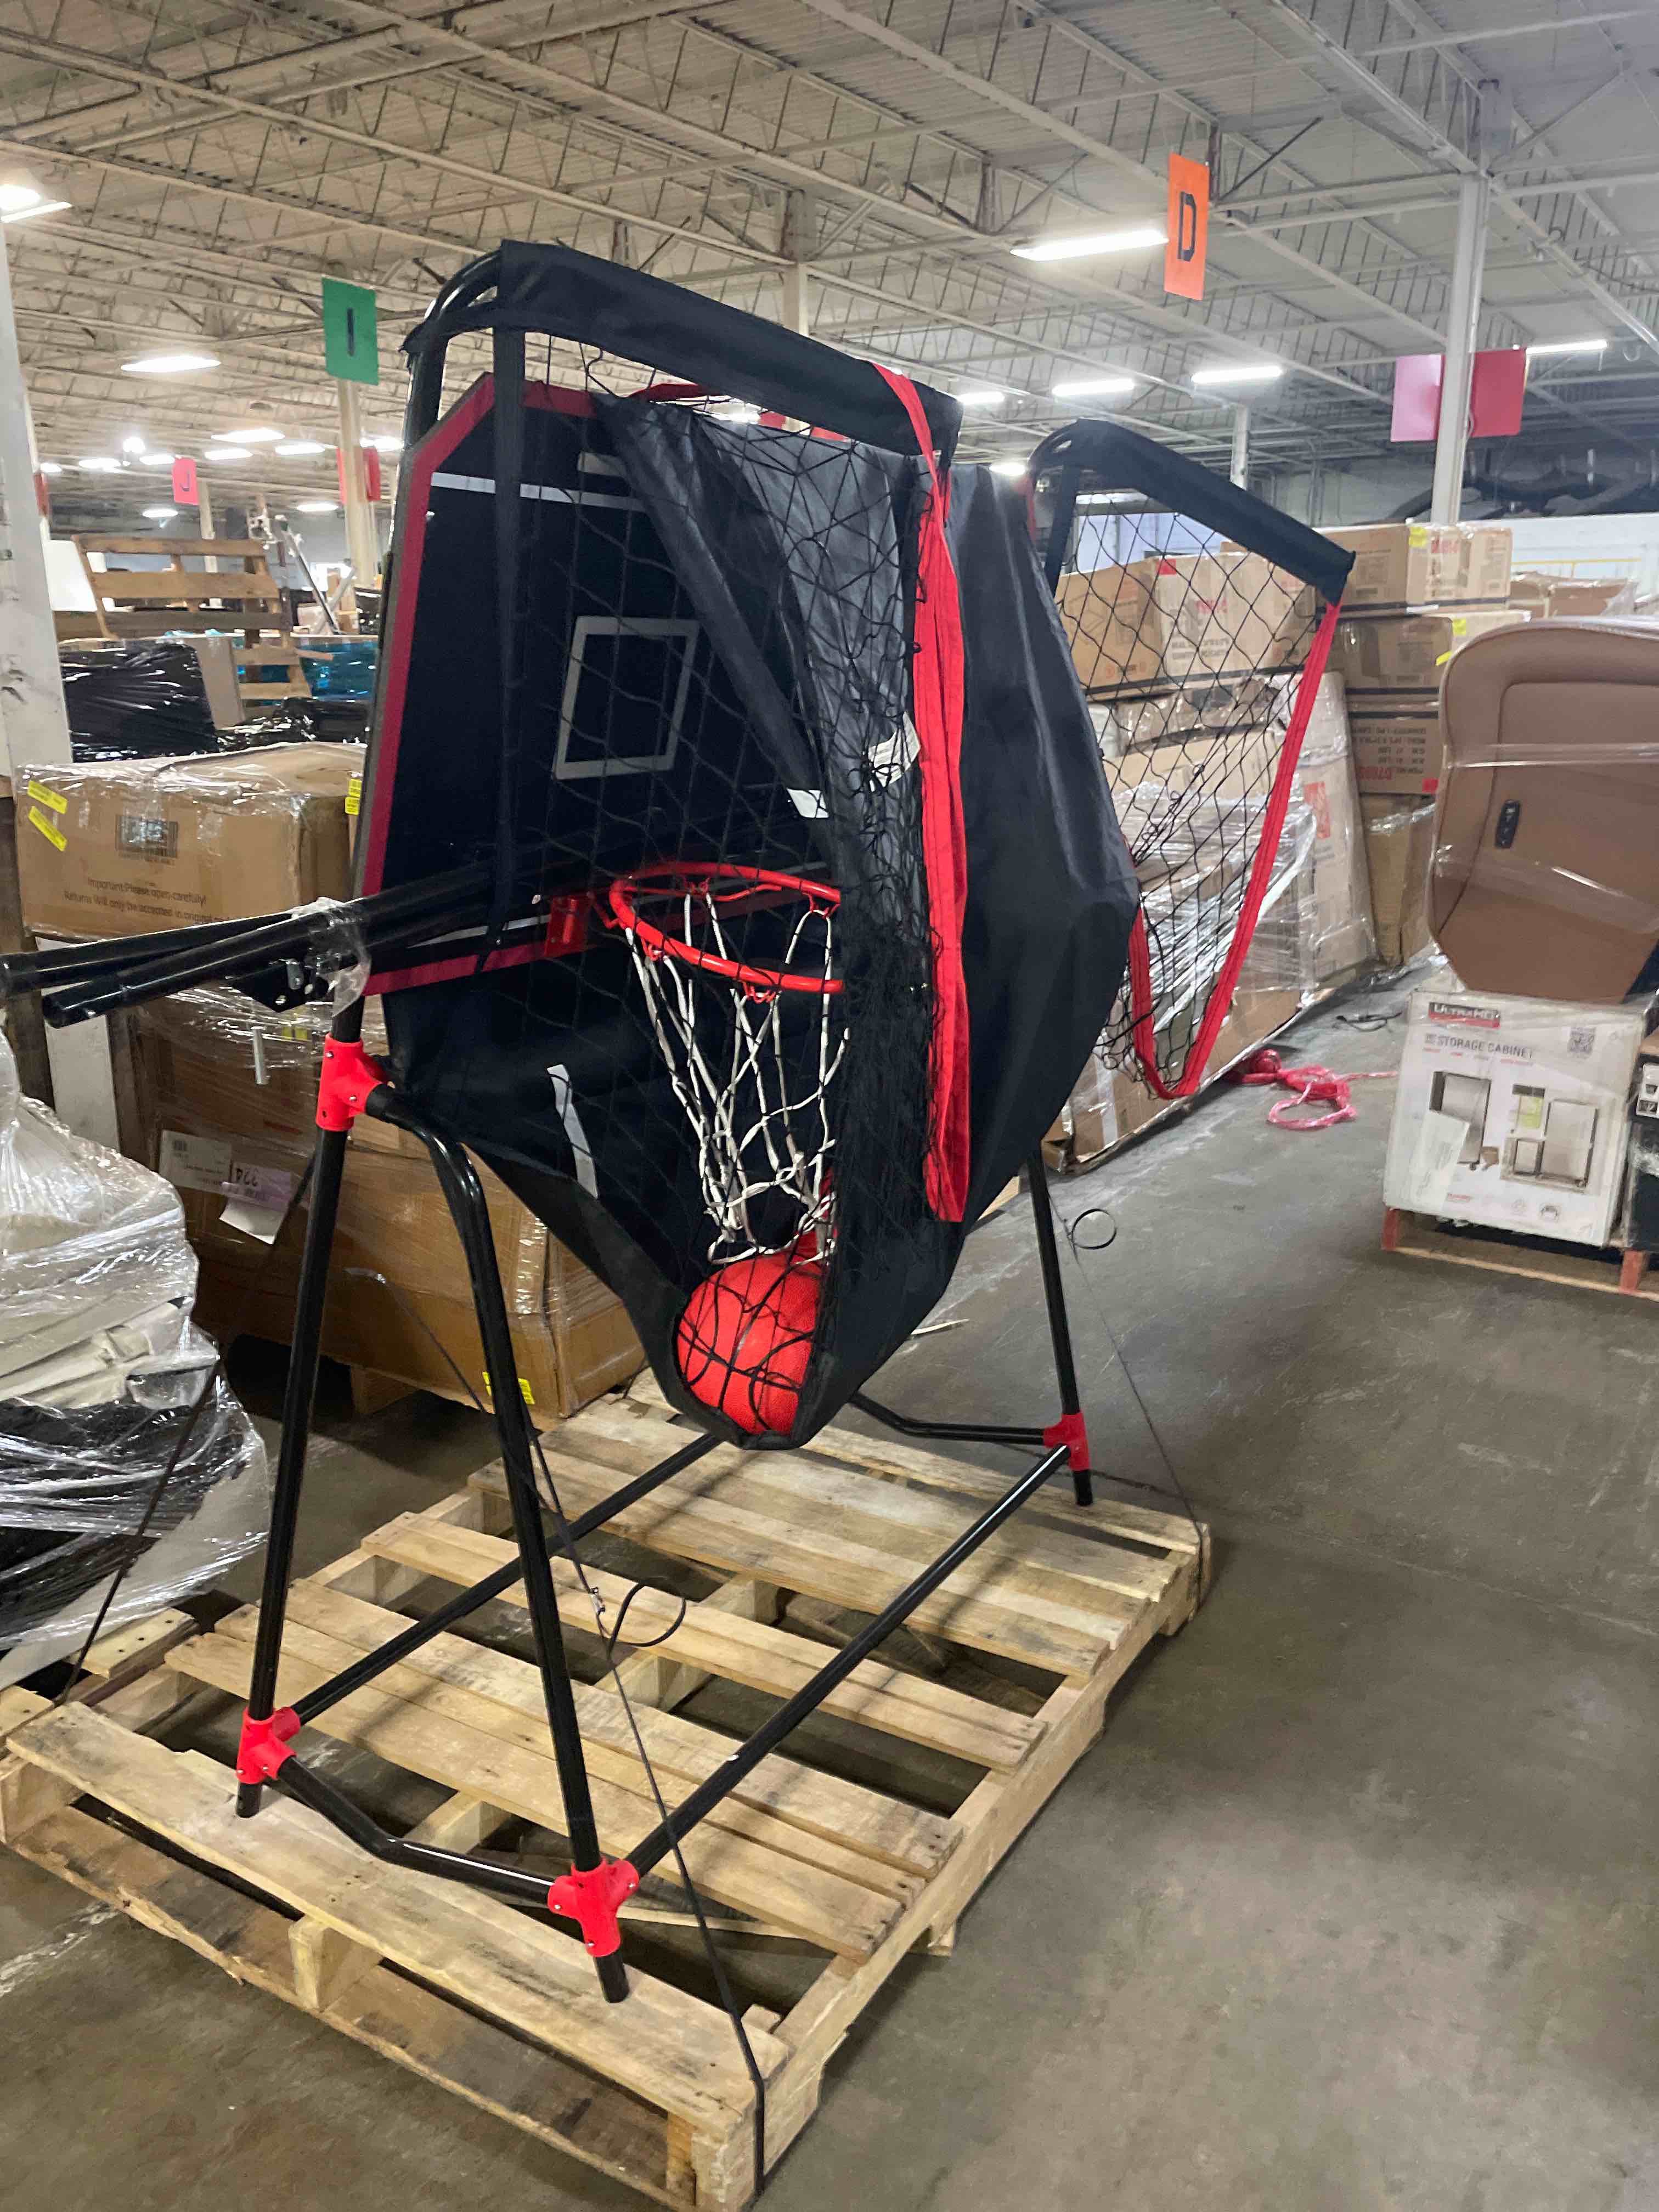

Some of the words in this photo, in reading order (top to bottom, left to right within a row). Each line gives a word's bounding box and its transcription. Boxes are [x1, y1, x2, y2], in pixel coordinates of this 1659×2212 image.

[1177, 191, 1197, 262] D
[1437, 1036, 1485, 1051] STORAGE
[1487, 1043, 1533, 1058] CABINET
